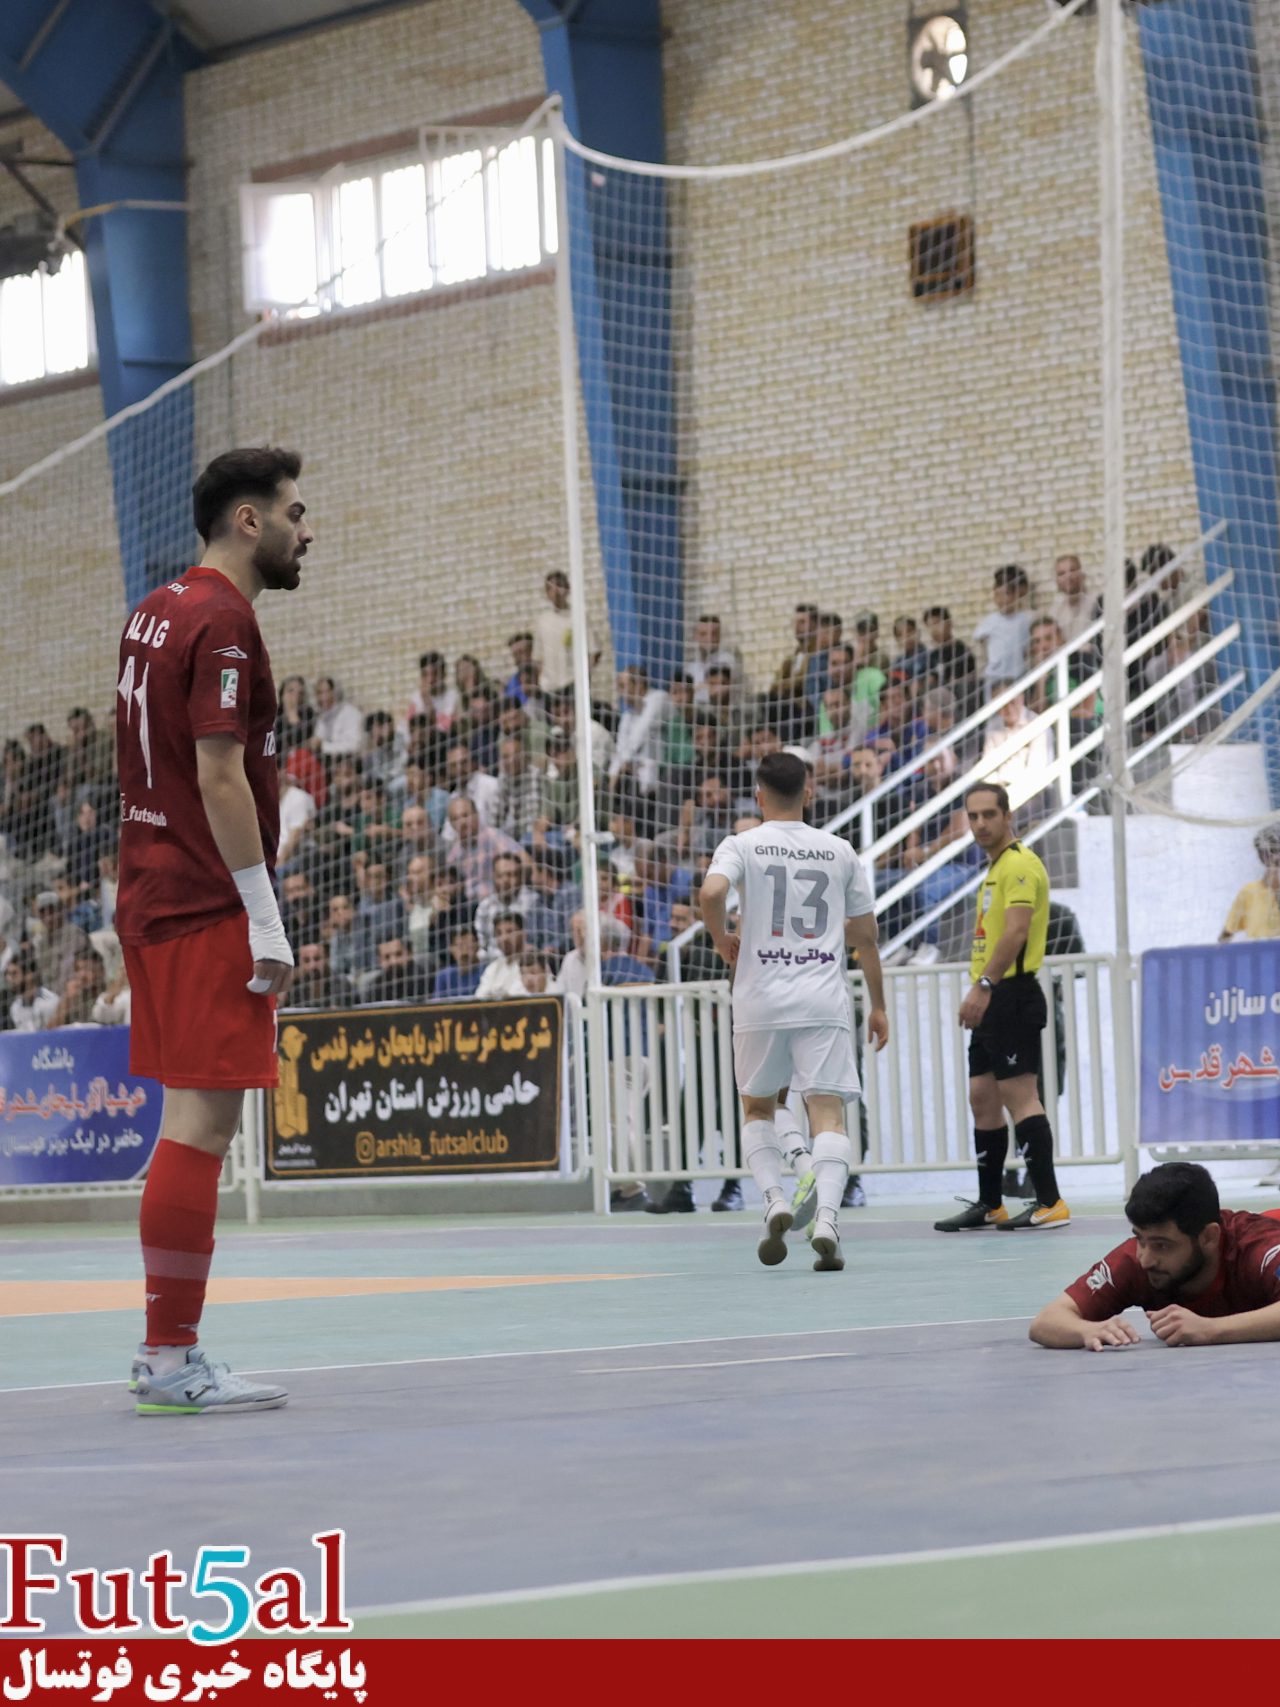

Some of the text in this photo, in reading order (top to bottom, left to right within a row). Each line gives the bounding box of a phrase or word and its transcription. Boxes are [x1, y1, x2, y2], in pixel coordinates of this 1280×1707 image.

[764, 864, 830, 939] 13
[1205, 986, 1266, 1025] سازان
[500, 1015, 553, 1061] شرکت
[1159, 1043, 1222, 1093] قدس
[1220, 1045, 1280, 1092] شهر
[324, 1070, 541, 1123] حامی ورزش استان تهران
[375, 1127, 510, 1162] arshia_futsalclub
